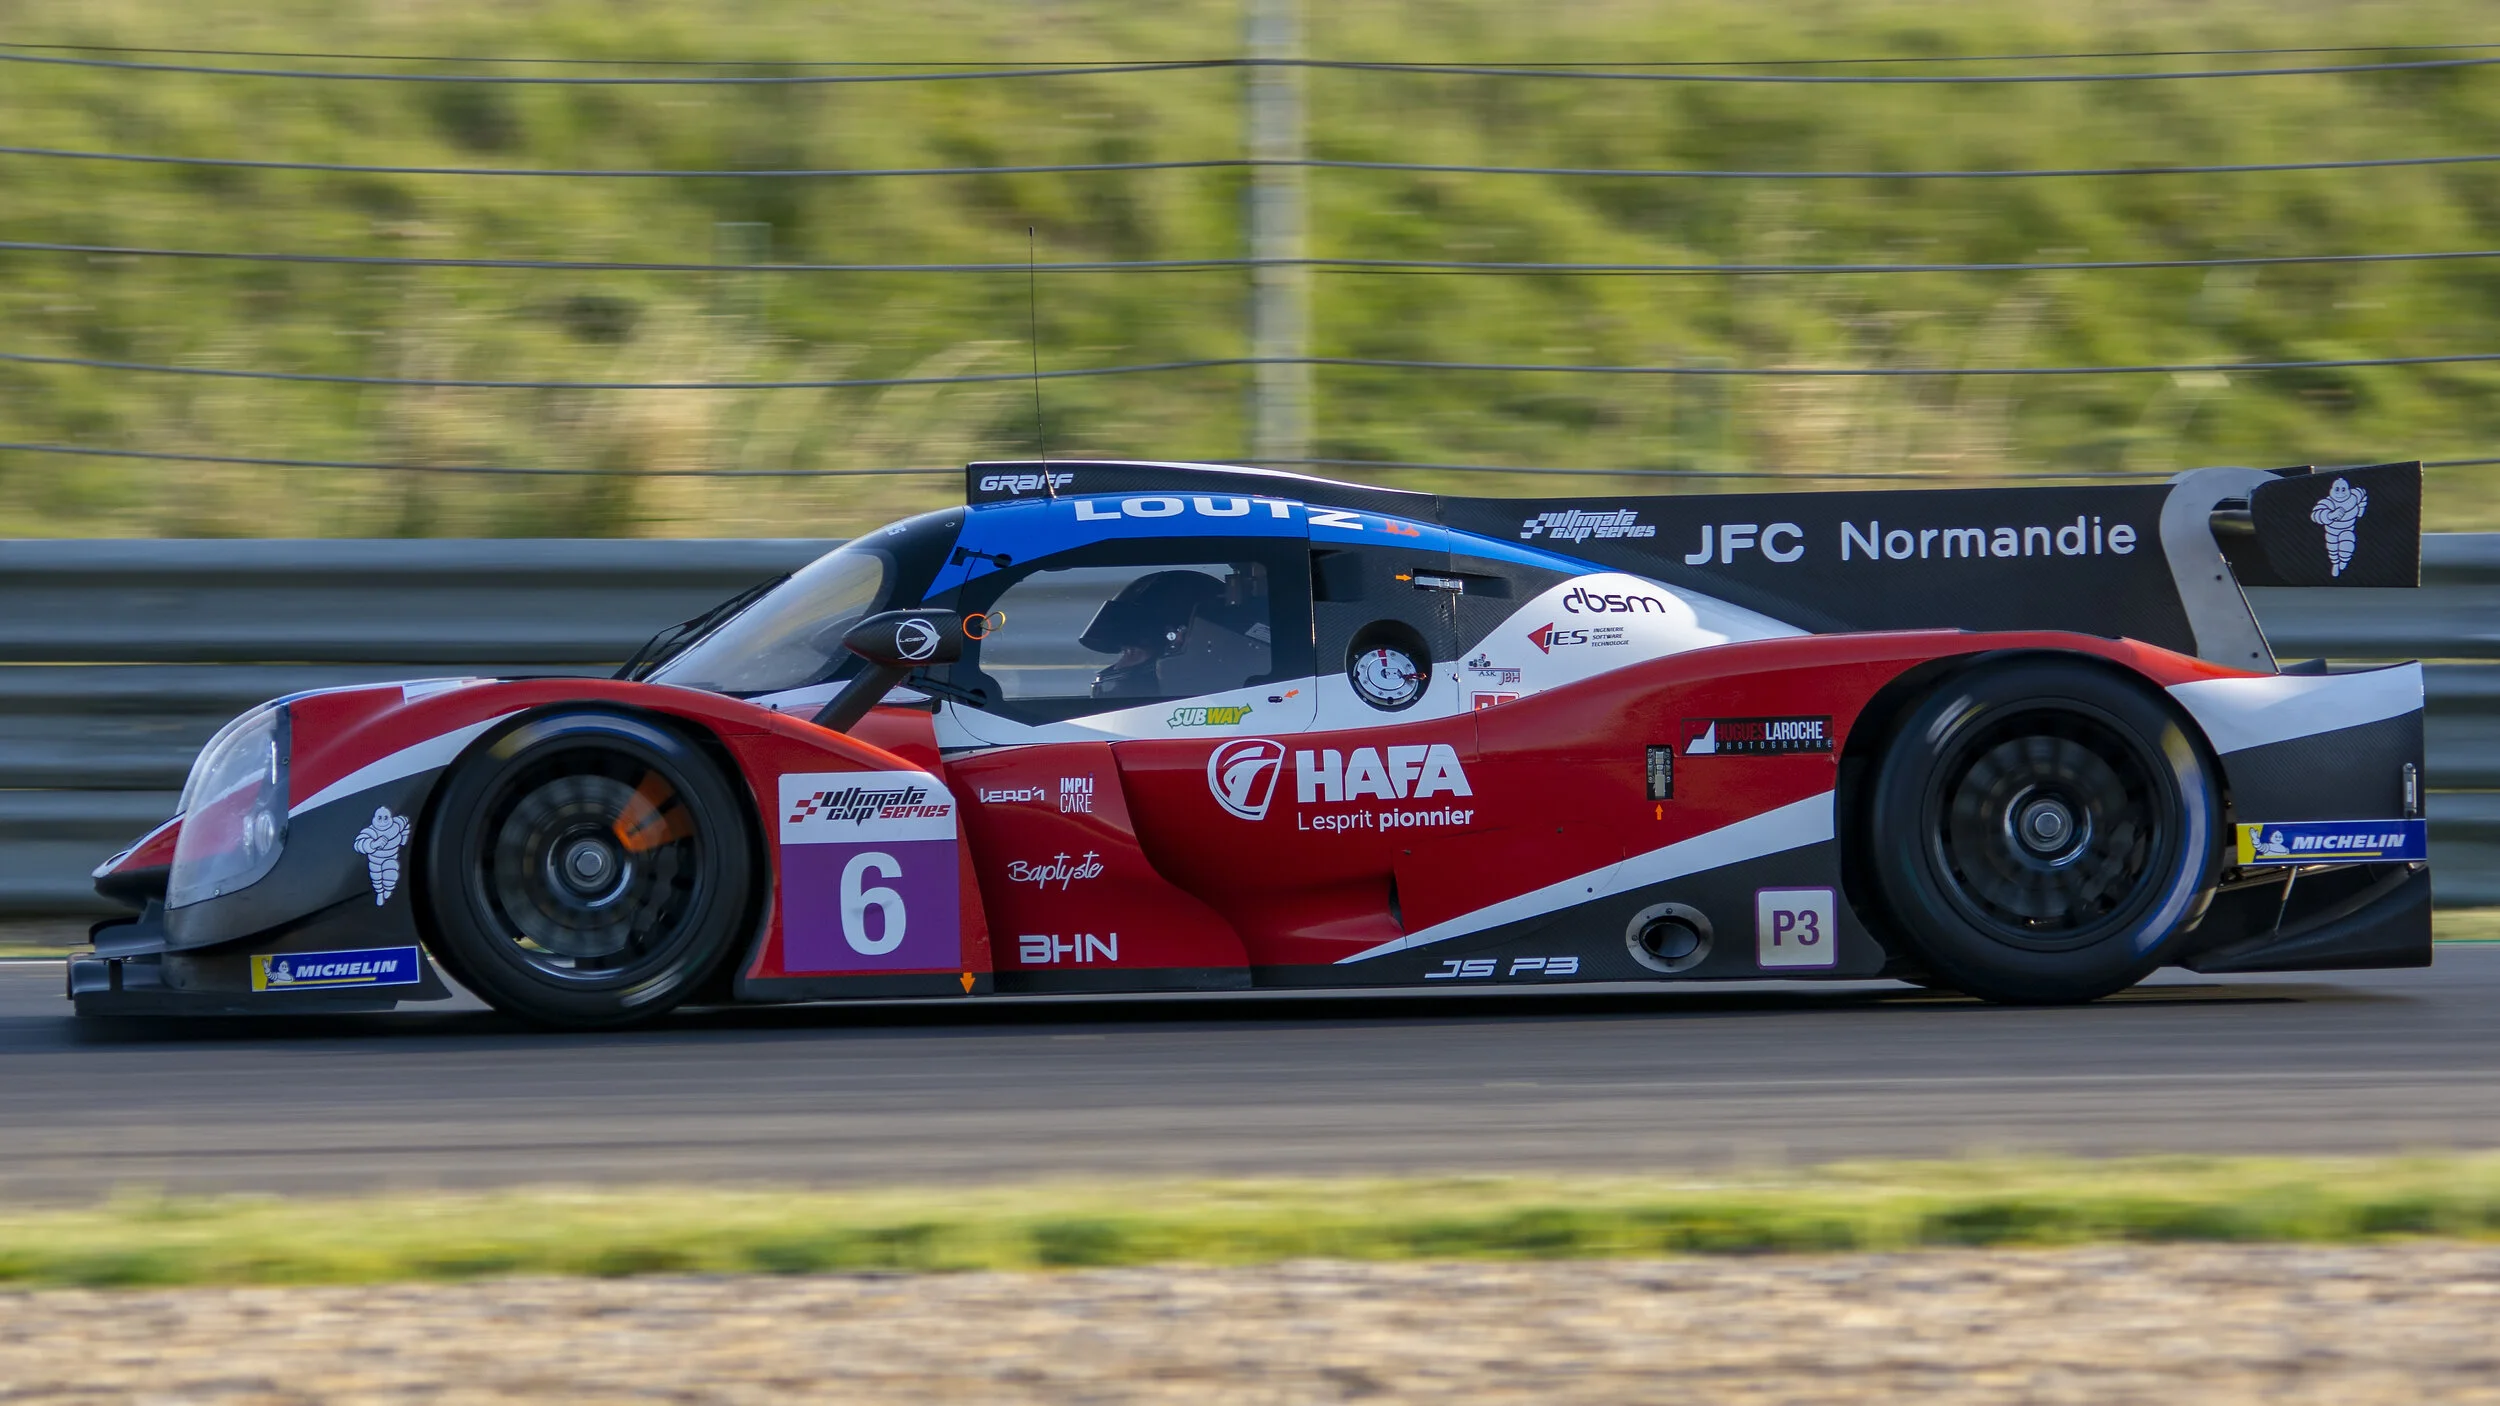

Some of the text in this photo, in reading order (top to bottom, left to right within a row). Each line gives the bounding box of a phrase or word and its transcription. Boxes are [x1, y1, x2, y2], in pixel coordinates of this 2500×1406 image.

[1074, 497, 1364, 531] LOUTZ
[1685, 516, 2137, 565] JFC Normandie
[1562, 587, 1666, 614] dbsm
[1167, 703, 1253, 729] SUBWAY
[1296, 744, 1473, 803] HAFA
[1060, 793, 1093, 813] CARE
[1380, 806, 1474, 832] pionnier
[2292, 833, 2406, 850] MICHELIN
[1007, 850, 1104, 890] Baptyste
[840, 852, 906, 956] 6
[1772, 910, 1820, 947] P3
[1019, 932, 1118, 964] BHN
[296, 959, 398, 978] MICHELIN
[1424, 958, 1498, 979] JS
